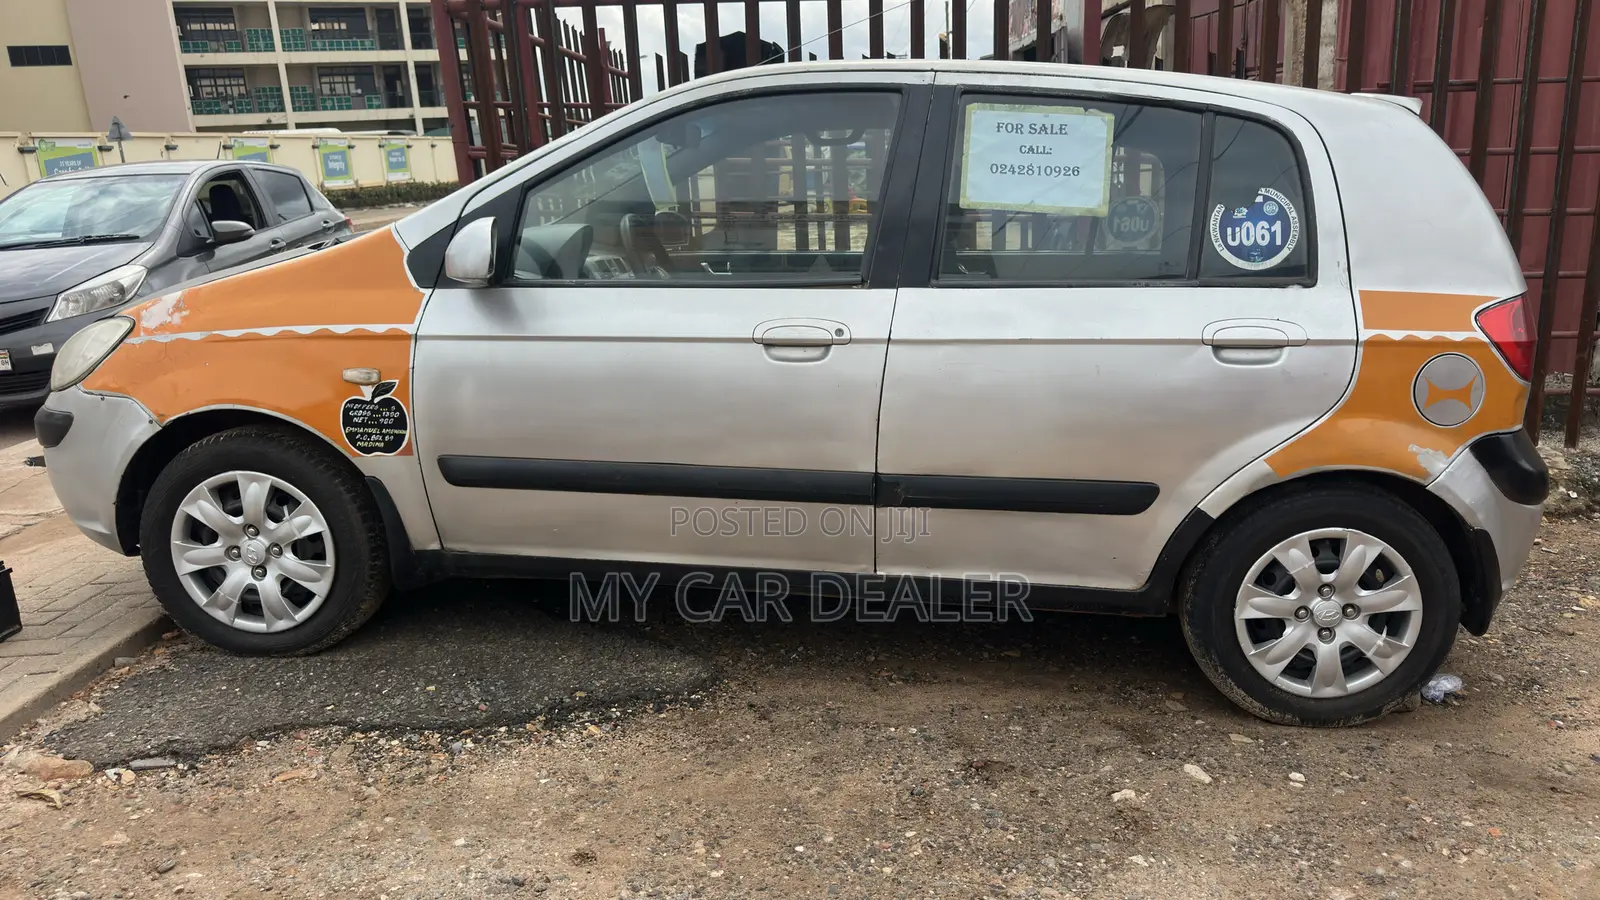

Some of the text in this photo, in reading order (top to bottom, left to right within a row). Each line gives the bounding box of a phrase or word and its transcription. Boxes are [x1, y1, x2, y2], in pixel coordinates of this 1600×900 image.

[996, 122, 1068, 135] FOR SALE
[1019, 145, 1052, 155] CALL:
[989, 163, 1080, 178] 0242810926
[1263, 187, 1299, 252] MUNICIPAL ASSEMBLY
